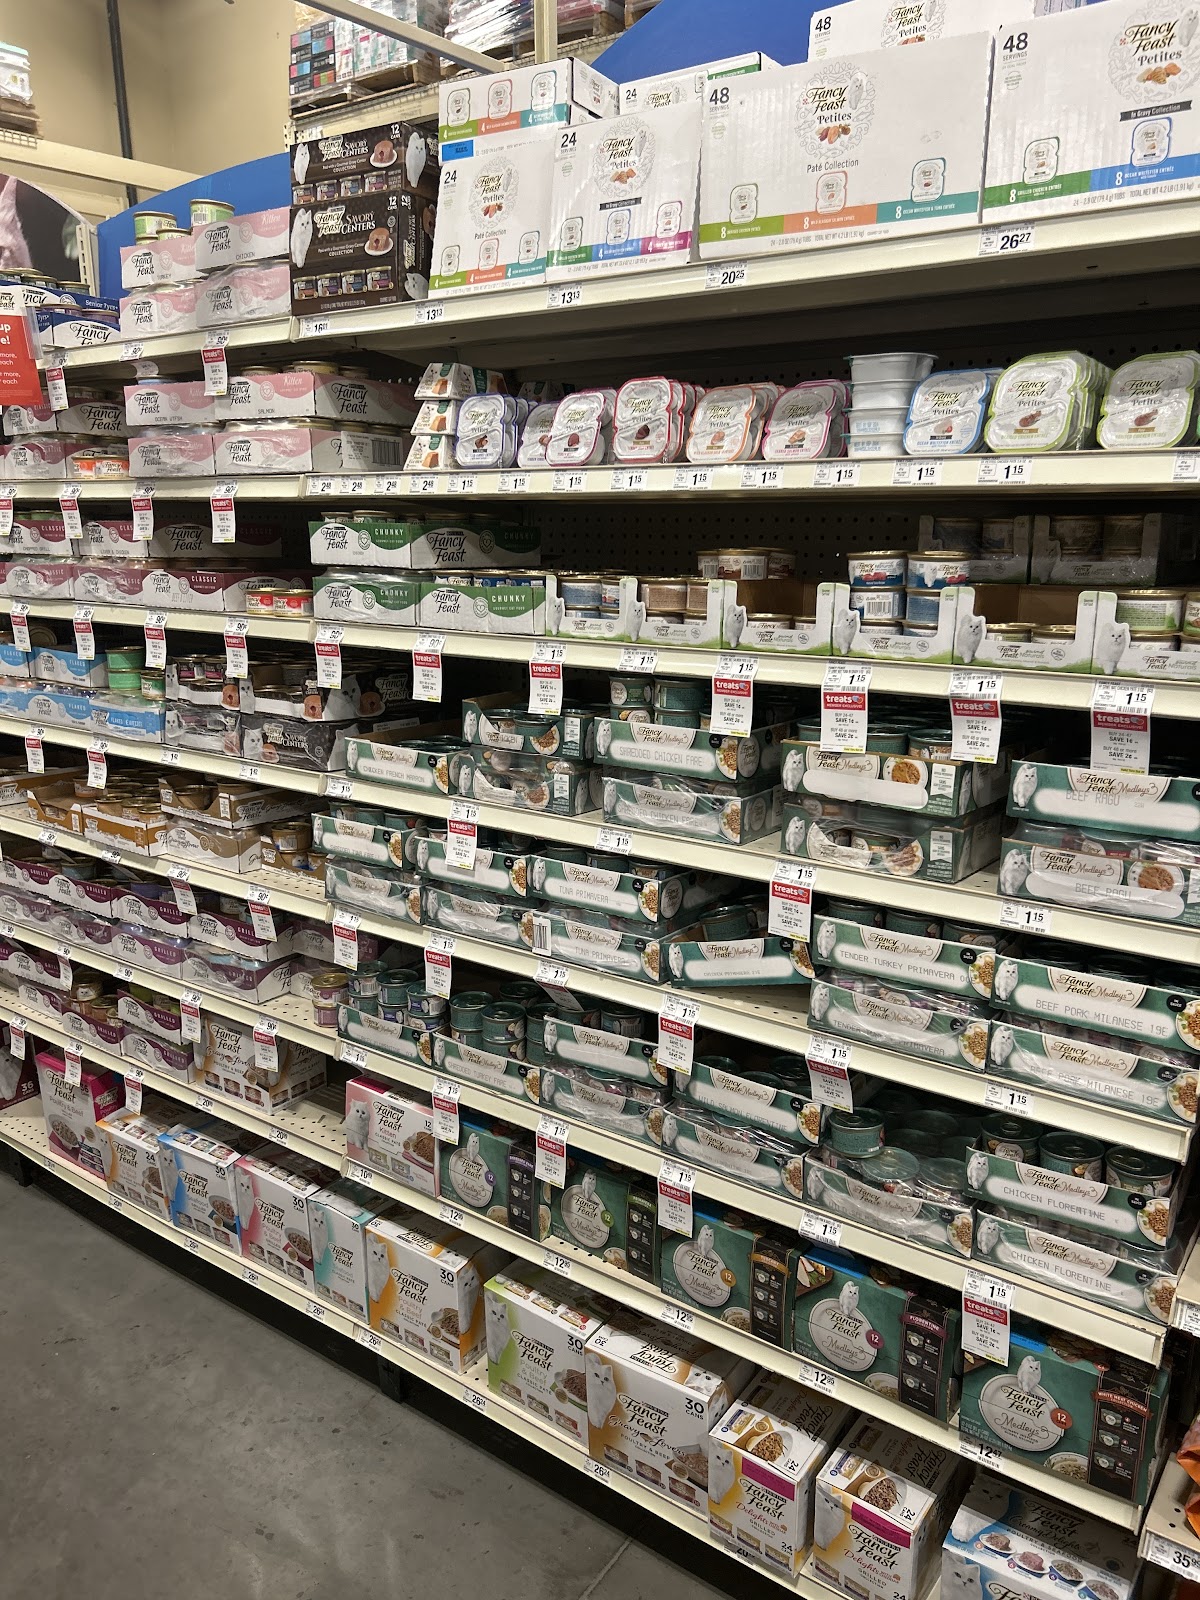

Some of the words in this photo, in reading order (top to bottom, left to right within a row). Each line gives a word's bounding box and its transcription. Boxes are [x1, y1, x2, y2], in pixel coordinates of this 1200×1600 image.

[814, 16, 831, 32] 48
[899, 23, 927, 38] Petites
[1125, 19, 1180, 43] Fancy
[1003, 32, 1028, 53] 48
[1132, 38, 1176, 57] Feast
[1002, 51, 1028, 61] SERVINGS
[1138, 50, 1182, 66] Petites
[709, 87, 729, 105] 48
[806, 85, 849, 104] Fancy
[709, 104, 729, 113] SERVINGS
[813, 98, 846, 115] Feast
[1152, 104, 1181, 115] Collection
[817, 111, 852, 125] Petites
[345, 139, 367, 149] SAVORY
[560, 132, 577, 148] 24
[603, 136, 635, 151] Fancy
[341, 147, 369, 158] CENTERS
[607, 146, 634, 161] Feast
[610, 158, 636, 170] Petites
[807, 163, 822, 173] Paté
[824, 159, 859, 171] Collection
[444, 169, 457, 184] 24
[1115, 172, 1123, 186] 8
[389, 197, 397, 205] 12
[483, 193, 504, 203] Petites
[1010, 189, 1017, 203] 8
[346, 211, 375, 222] SAVORY
[341, 221, 376, 234] CENTERS
[486, 228, 507, 238] Collection
[204, 228, 231, 242] Fancy
[210, 239, 231, 254] Feast
[235, 251, 255, 260] CHICKEN
[85, 300, 103, 309] Senior
[70, 323, 112, 342] Fancy
[1011, 380, 1049, 394] Fancy
[1018, 387, 1045, 399] Feast
[320, 526, 348, 539] Fancy
[374, 528, 404, 536] CHUNKY
[327, 538, 348, 550] Feast
[191, 575, 217, 583] CLASSIC
[431, 590, 462, 602] Fancy
[491, 594, 526, 603] CHUNKY
[438, 601, 462, 615] Feast
[1001, 651, 1018, 659] Feast
[715, 680, 739, 690] treats
[826, 694, 852, 703] treats
[955, 701, 984, 710] treats
[1097, 714, 1130, 723] treats
[637, 725, 663, 738] Fancy
[643, 735, 663, 745] Feast
[619, 747, 650, 758] SHREDDED
[654, 751, 683, 763] CHICKEN
[686, 754, 703, 767] FARE
[1077, 773, 1116, 788] Fancy
[1086, 783, 1116, 794] Feast
[1066, 790, 1088, 802] BEEF
[1095, 793, 1120, 806] RAGU
[559, 885, 574, 896] TUNA
[576, 888, 609, 904] PRIMAVERA
[1075, 883, 1101, 895] BEEF
[839, 950, 873, 964] TENDER
[874, 957, 904, 971] TURKEY
[908, 964, 955, 982] PRIMAVERA
[1056, 973, 1093, 989] Fancy
[1065, 985, 1092, 996] Feast
[153, 1012, 176, 1025] GRILLED
[1035, 998, 1060, 1012] BEEF
[1064, 1003, 1090, 1018] PORK
[1093, 1009, 1144, 1029] MILANESE
[1149, 1023, 1169, 1037] 19E
[208, 1024, 243, 1045] Fancy
[217, 1038, 243, 1055] Feast
[21, 1081, 35, 1092] 36
[255, 1198, 285, 1220] Fancy
[292, 1195, 305, 1209] 30
[1002, 1185, 1044, 1204] CHICKEN
[1047, 1198, 1106, 1222] FLORENTINE
[261, 1214, 285, 1231] Feast
[439, 1268, 455, 1283] 30
[1011, 1249, 1050, 1268] CHICKEN
[1054, 1263, 1112, 1293] FLORENTINE
[390, 1267, 429, 1295] Fancy
[440, 1279, 455, 1288] CANS
[398, 1284, 428, 1305] Feast
[966, 1300, 994, 1315] treats
[909, 1314, 940, 1332] FLORENTINE
[567, 1333, 584, 1350] 30
[870, 1334, 879, 1343] 12
[567, 1347, 584, 1356] CANS
[528, 1371, 548, 1384] Beef
[617, 1393, 669, 1425] Fancy
[684, 1397, 705, 1414] 30
[1098, 1391, 1112, 1400] WHITE
[1113, 1395, 1125, 1404] MEAT
[1126, 1398, 1148, 1413] CHICKEN
[628, 1411, 668, 1437] Feast
[1056, 1411, 1067, 1423] 12
[739, 1478, 786, 1510] Fancy
[736, 1501, 769, 1526] Delights
[749, 1497, 785, 1521] Feast
[749, 1519, 776, 1537] GRILLED
[844, 1548, 881, 1575] Delights
